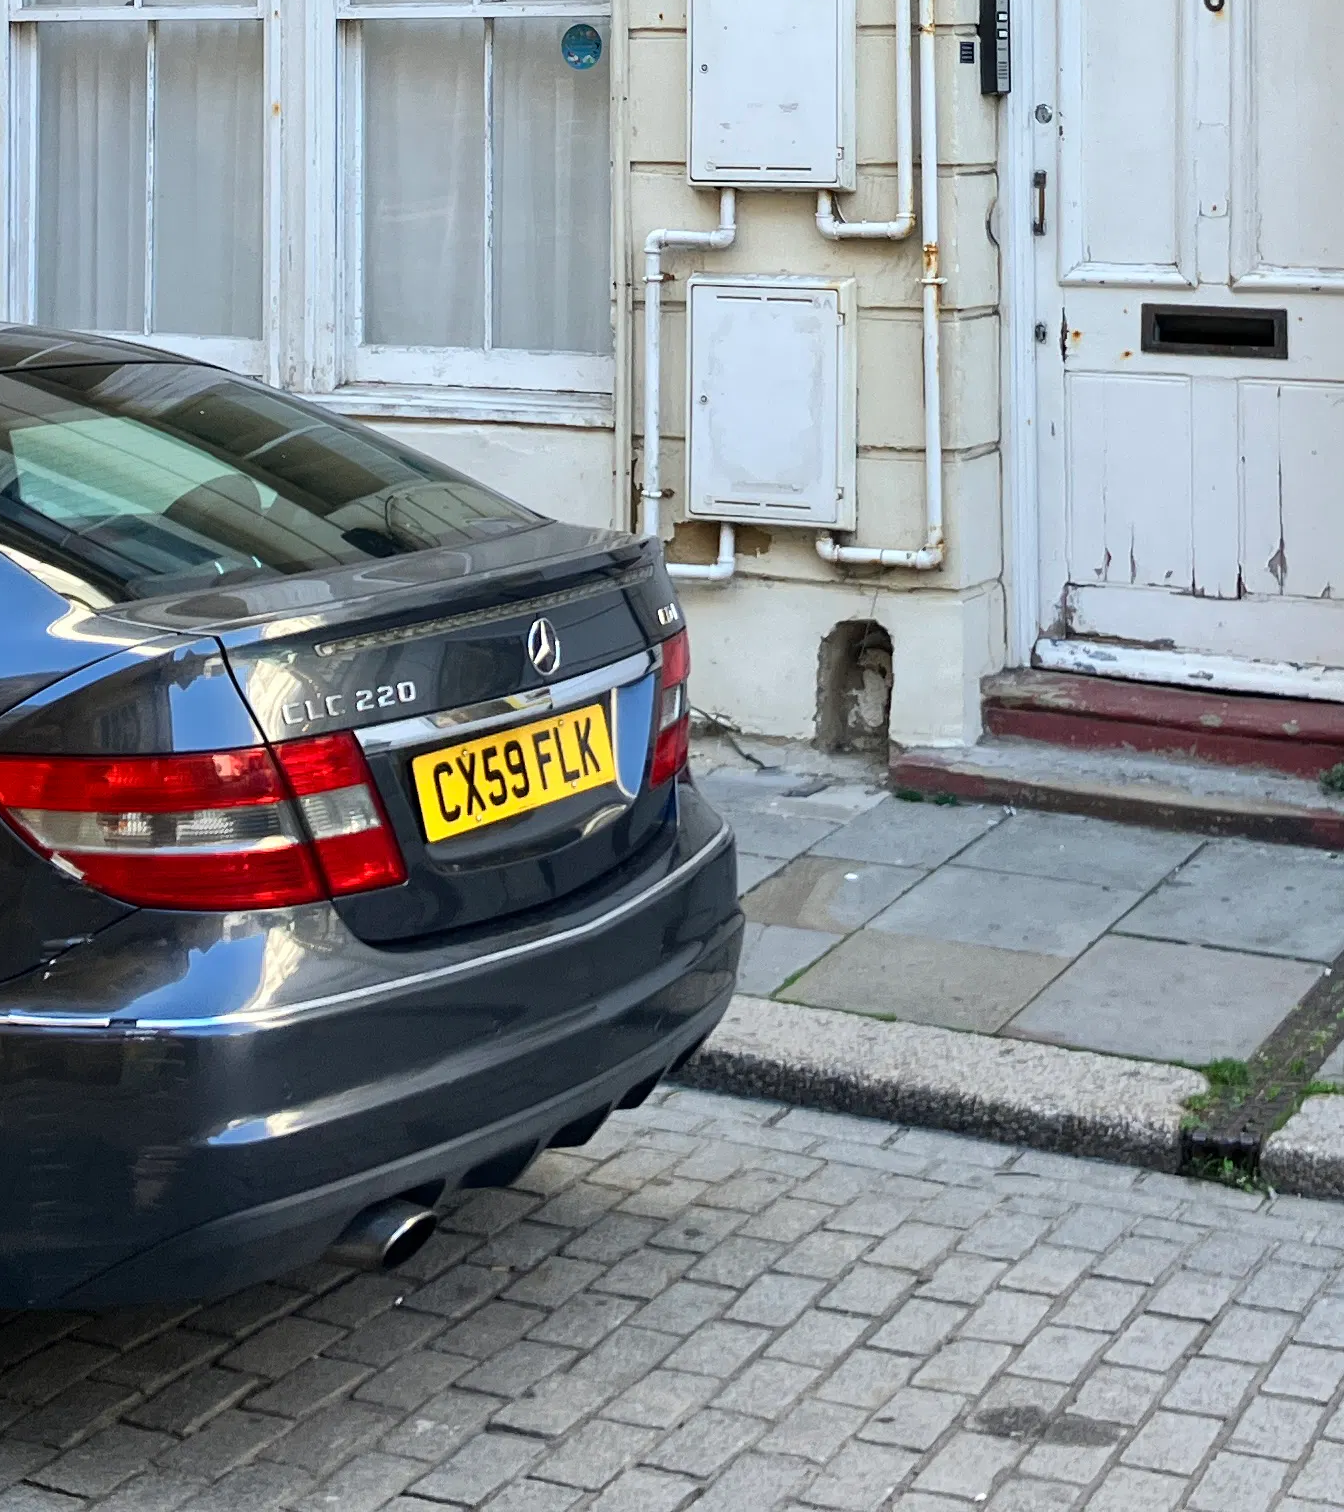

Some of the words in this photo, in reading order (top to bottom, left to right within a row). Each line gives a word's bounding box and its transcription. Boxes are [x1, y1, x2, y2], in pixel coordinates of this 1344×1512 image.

[282, 695, 346, 724] CLC
[356, 681, 416, 712] 220
[434, 740, 530, 822] CX59
[532, 717, 601, 790] FLK
